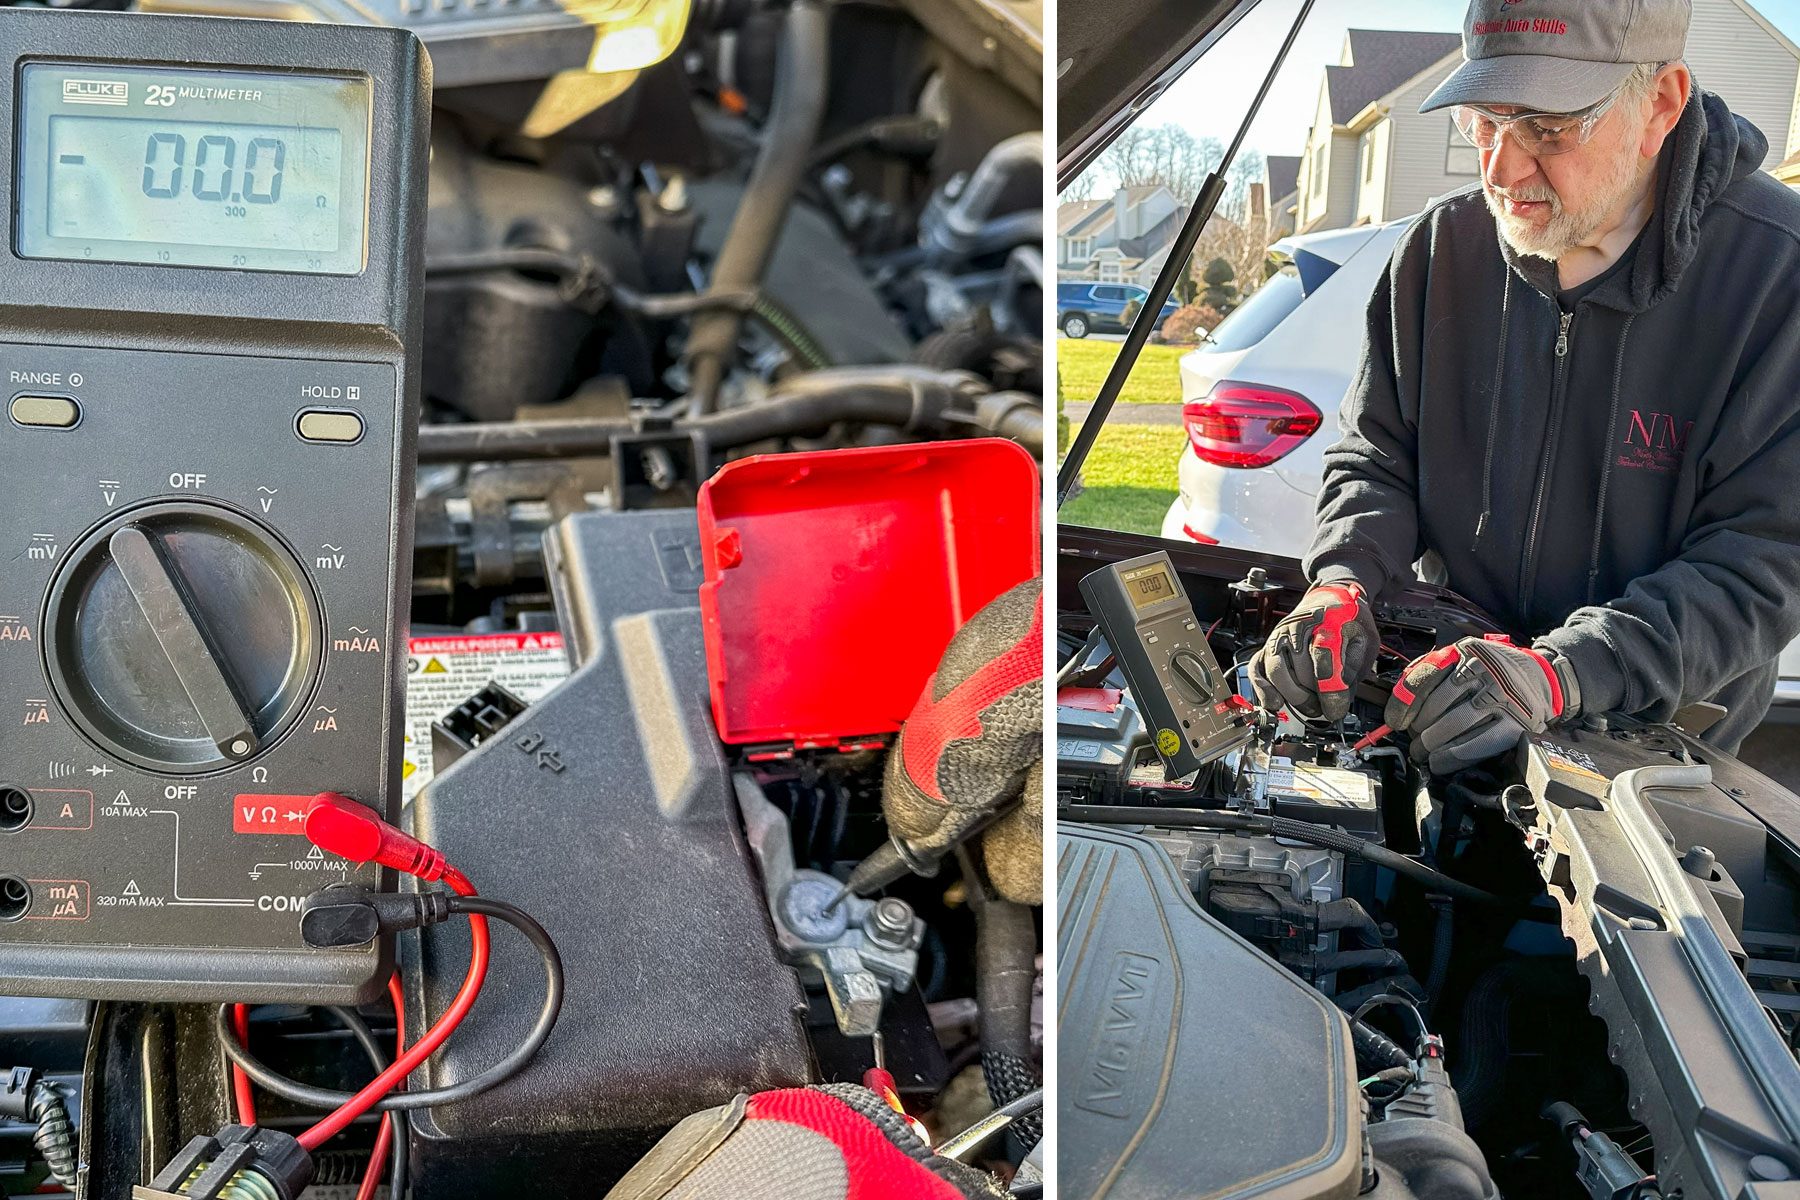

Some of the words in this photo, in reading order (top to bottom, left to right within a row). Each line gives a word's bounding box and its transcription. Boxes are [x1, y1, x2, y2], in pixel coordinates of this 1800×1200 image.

[1504, 19, 1530, 33] Auto
[1533, 18, 1567, 35] Skills
[64, 80, 127, 96] FLUKE
[144, 84, 176, 107] 25
[178, 87, 262, 101] MULTIMETER
[224, 206, 247, 219] 300
[84, 247, 92, 258] 0
[156, 251, 170, 262] 10
[232, 255, 246, 266] 20
[307, 258, 322, 270] 30
[10, 371, 62, 386] RANGE
[300, 385, 342, 400] HOLD
[169, 472, 207, 489] OFF
[103, 491, 117, 507] V
[260, 498, 273, 514] V
[28, 544, 58, 560] mV
[316, 554, 345, 570] mV
[333, 637, 380, 654] mA/A
[164, 785, 198, 800] OFF
[60, 803, 73, 818] A
[100, 806, 122, 818] 10A
[124, 806, 148, 818] MAX
[243, 807, 256, 823] V
[289, 860, 321, 872] 1000V
[323, 860, 348, 872] MAX
[49, 884, 80, 900] mA
[96, 896, 117, 907] 320
[119, 897, 137, 907] mA
[138, 896, 164, 907] MAX
[257, 895, 305, 912] COM
